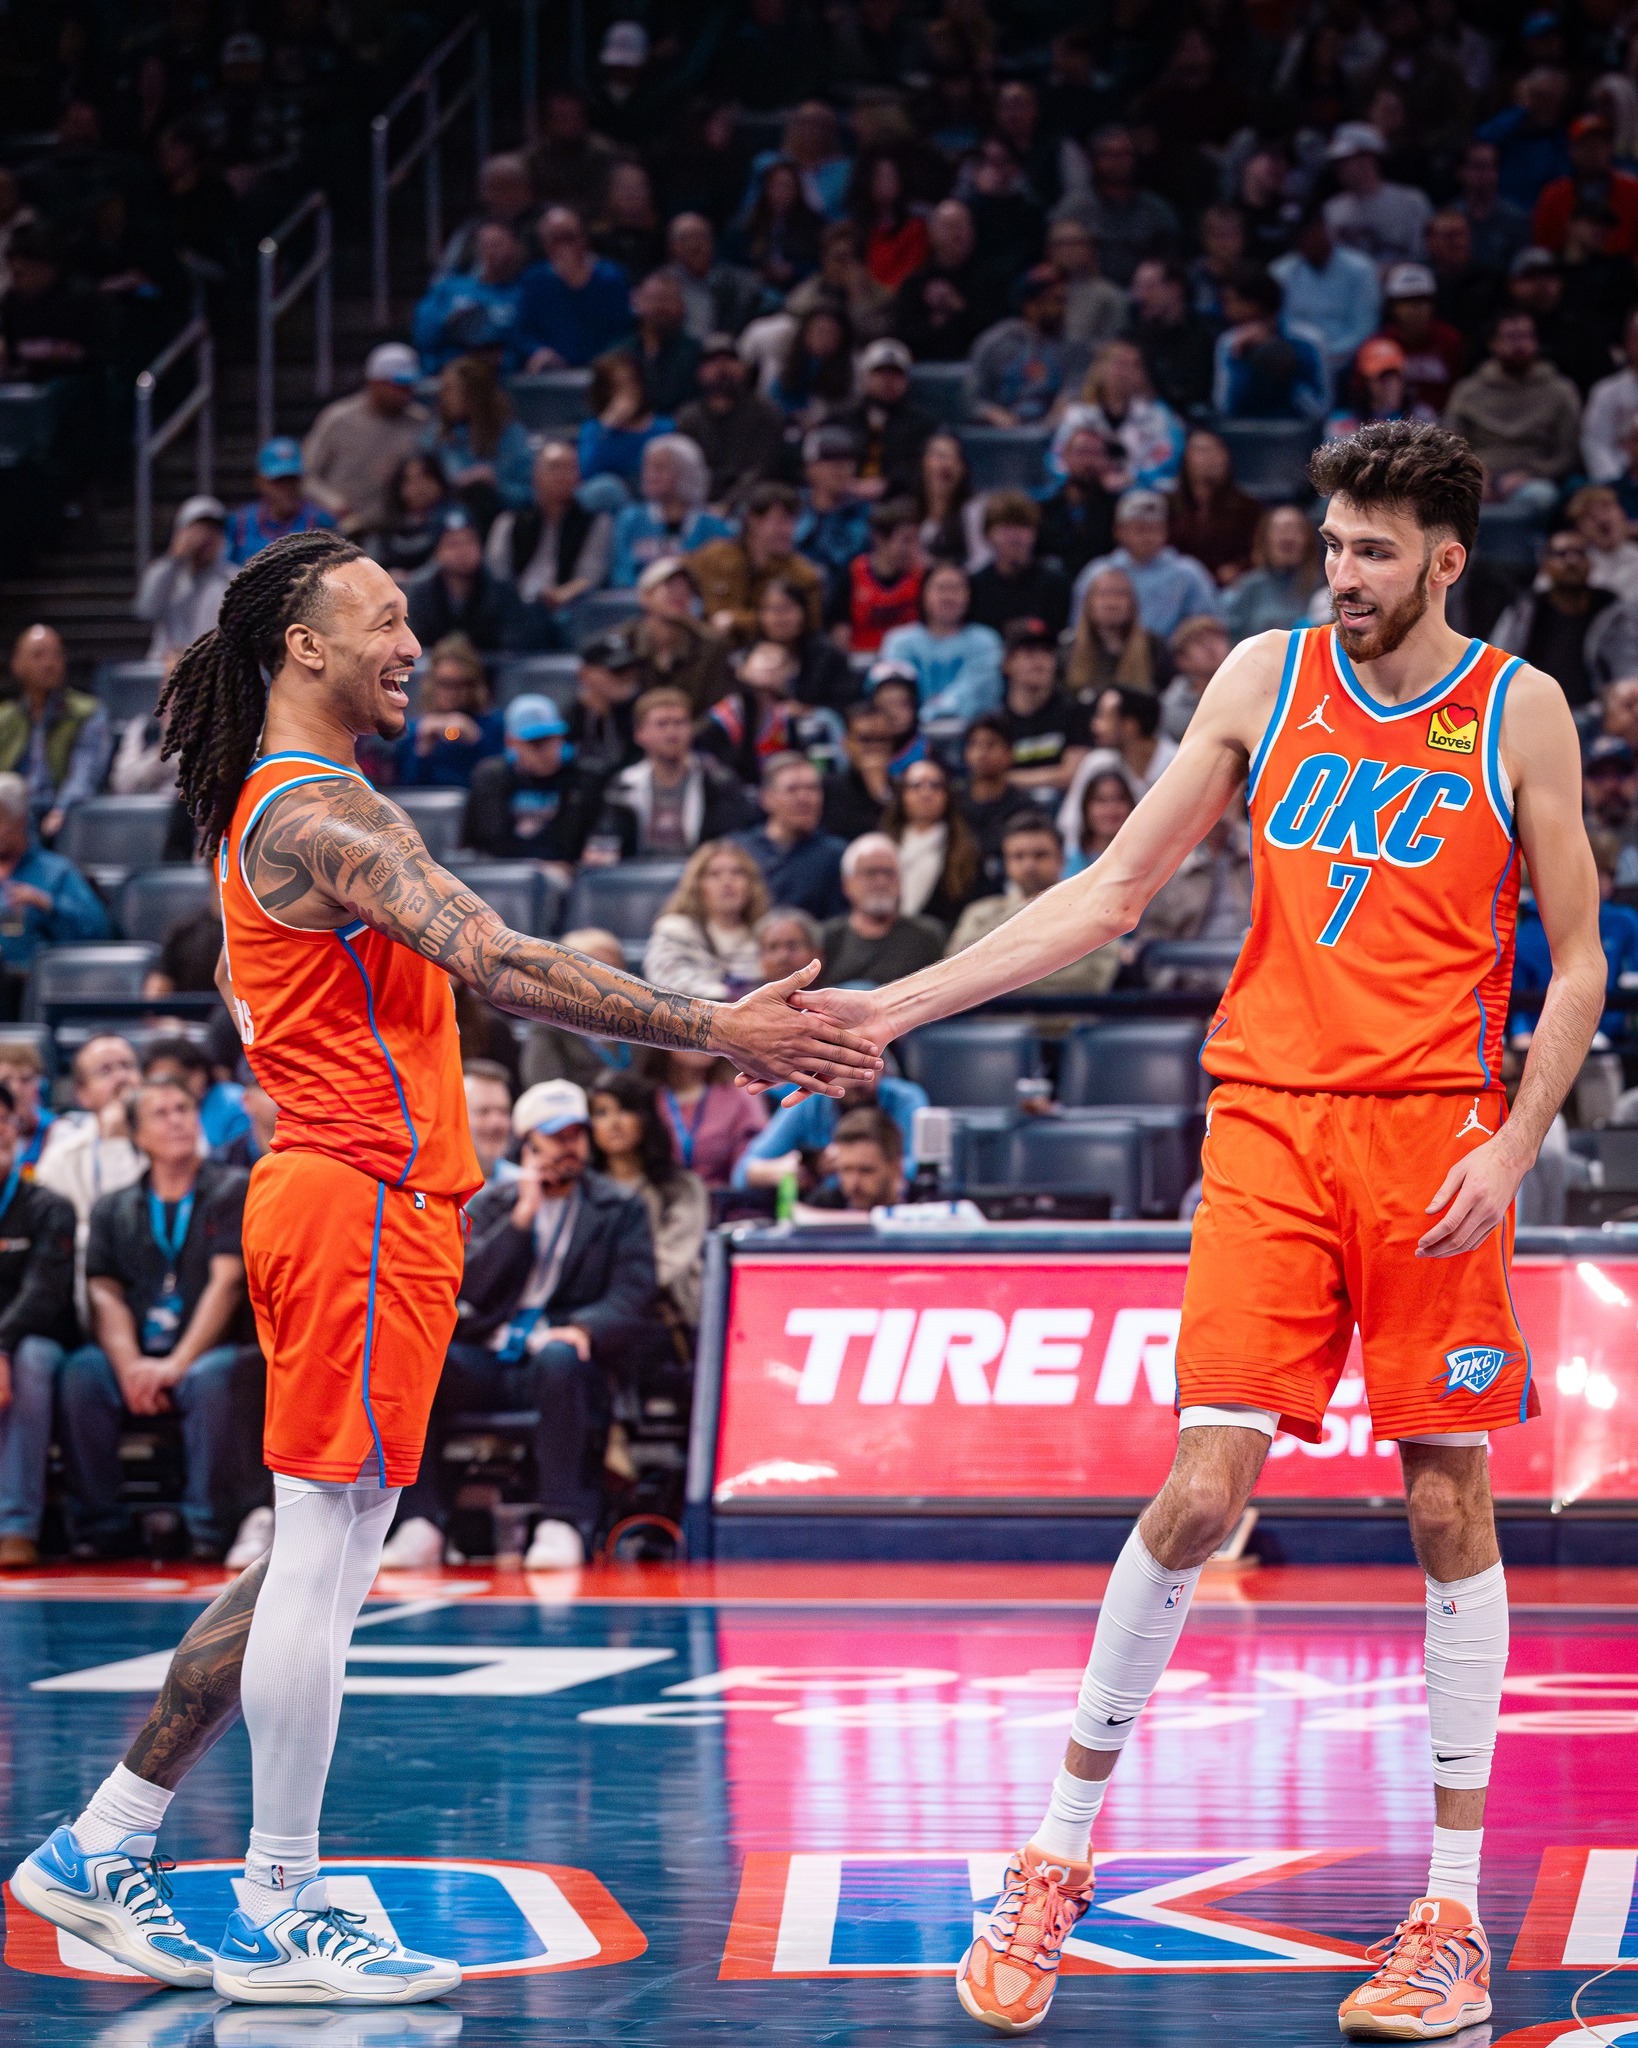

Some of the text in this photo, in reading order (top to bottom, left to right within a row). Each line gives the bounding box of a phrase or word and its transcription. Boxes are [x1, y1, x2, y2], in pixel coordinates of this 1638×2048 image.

[345, 838, 374, 864] FORT
[1264, 753, 1473, 868] OKC
[1315, 861, 1372, 948] 7
[785, 1308, 1093, 1404] TIRE
[1448, 1354, 1492, 1387] OKC
